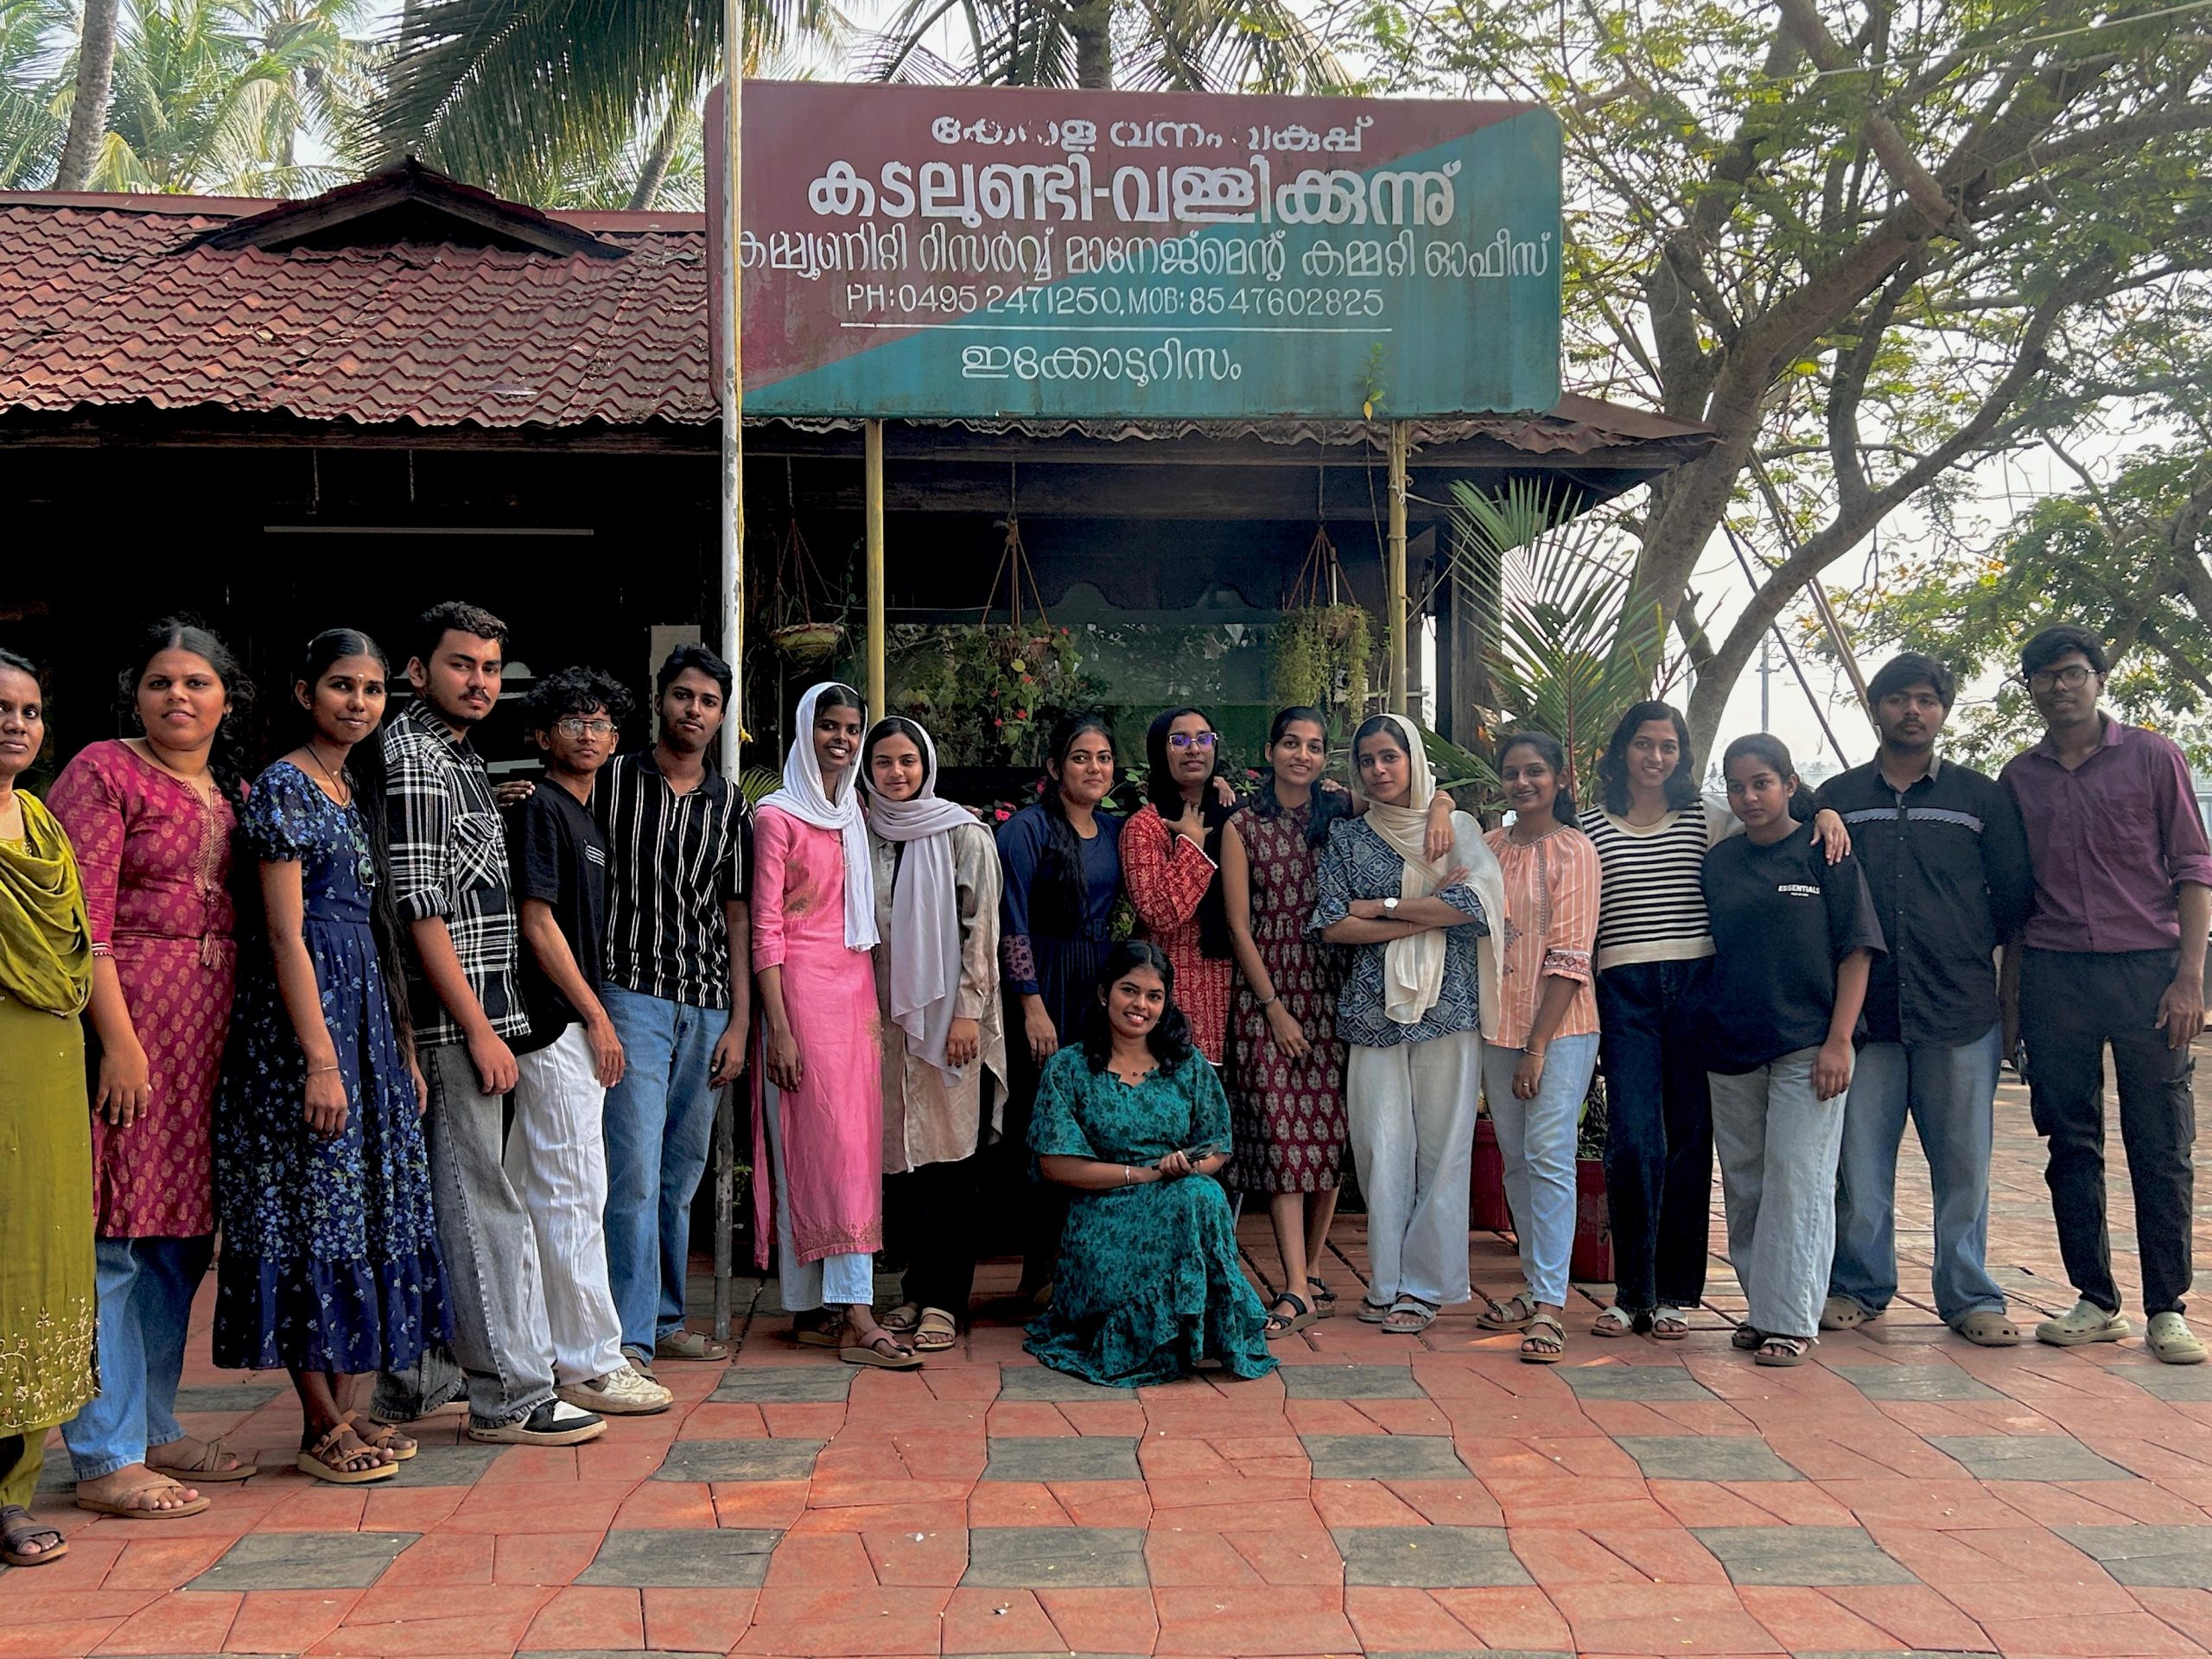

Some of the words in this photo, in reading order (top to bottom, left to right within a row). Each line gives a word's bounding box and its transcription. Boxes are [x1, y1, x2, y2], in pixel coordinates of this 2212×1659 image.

[1301, 228, 1416, 277] കമ്മറ്റി
[1424, 227, 1552, 277] ഓഫീസ്
[846, 283, 978, 313] PH:0495
[1777, 884, 1821, 894] ESSENTIALS
